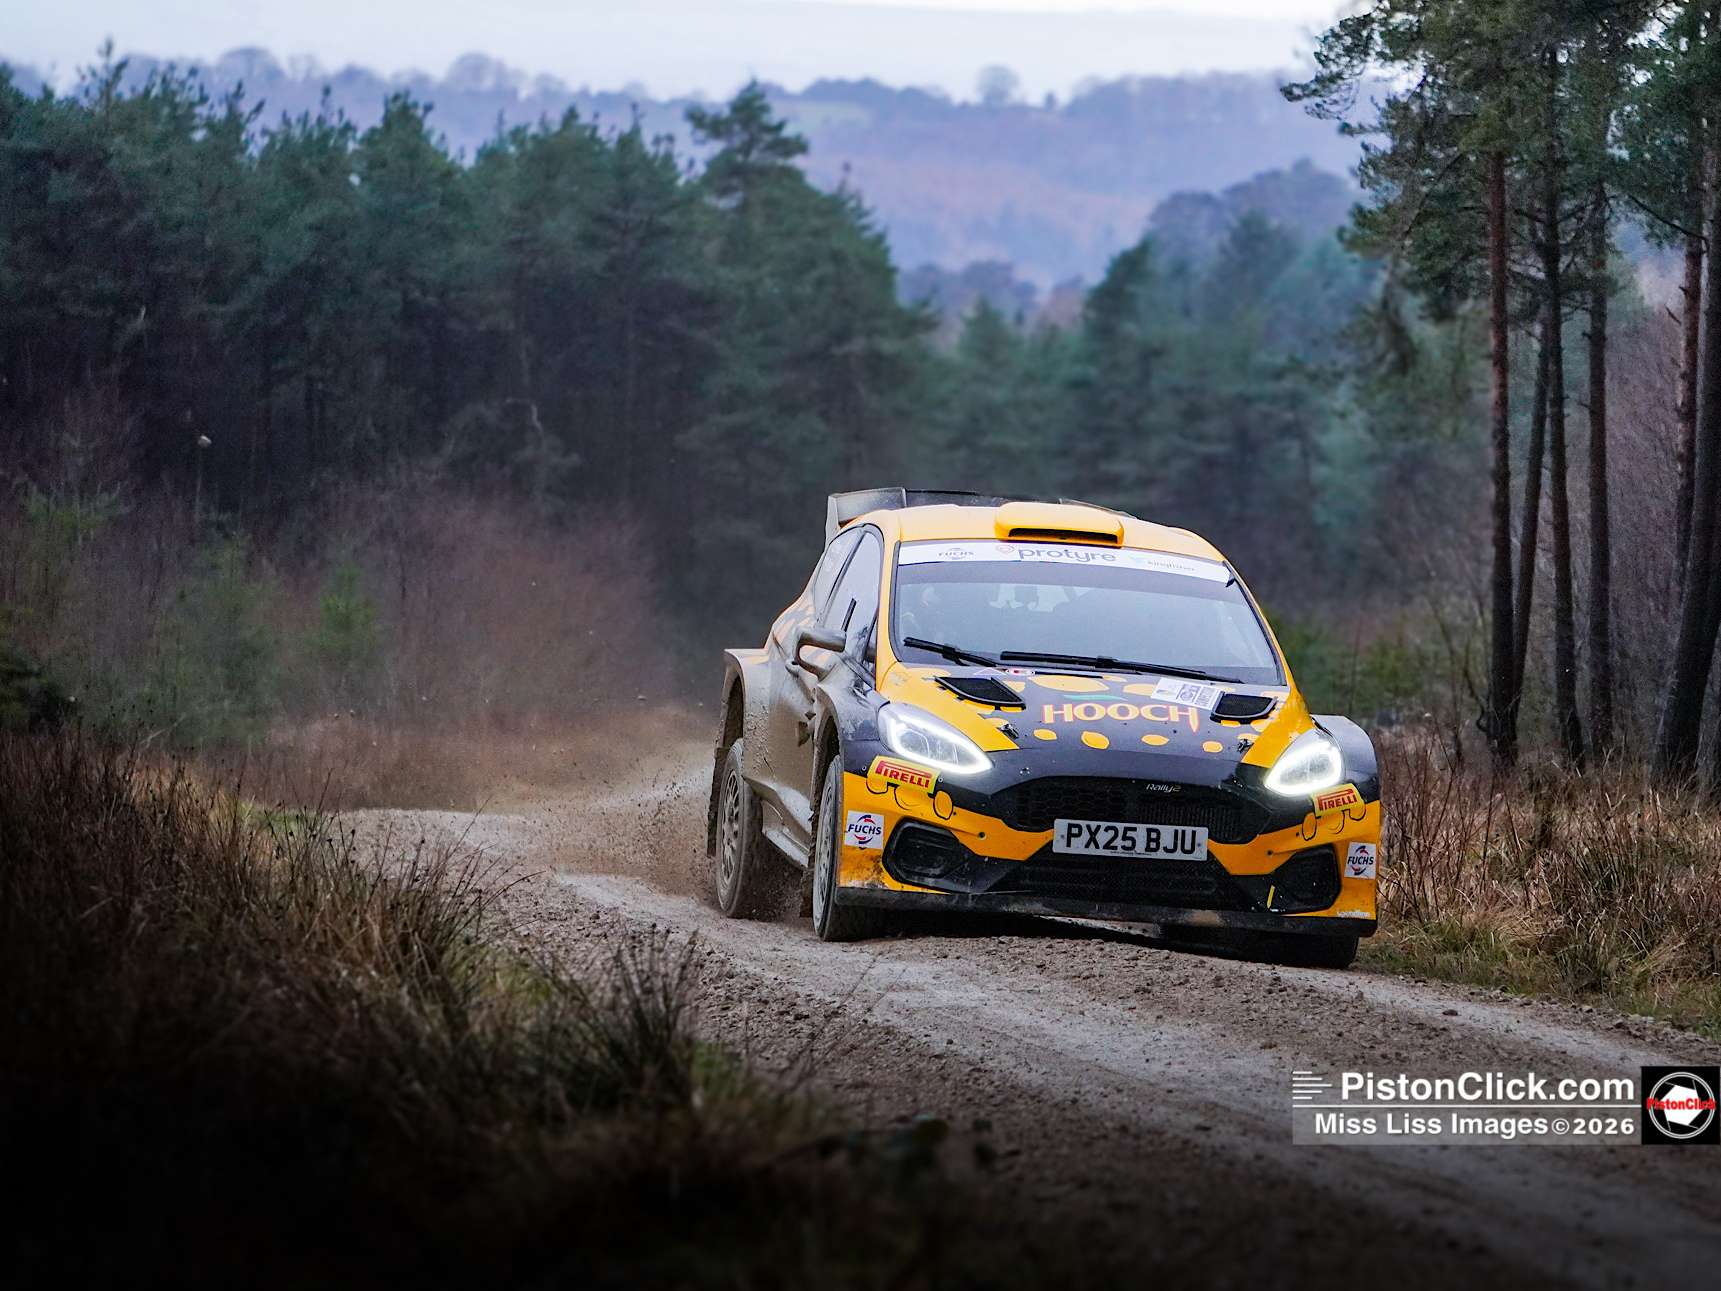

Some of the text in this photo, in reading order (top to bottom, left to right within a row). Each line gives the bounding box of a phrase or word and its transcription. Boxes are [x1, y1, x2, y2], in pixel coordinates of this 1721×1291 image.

[1018, 548, 1116, 562] protyre
[1042, 702, 1199, 733] HOOCH
[875, 760, 933, 788] PIRELLI
[1145, 783, 1181, 793] Rally2
[1316, 788, 1358, 811] PIRELLI
[847, 823, 882, 836] FUCHS
[1066, 823, 1197, 854] PX25 BJU
[1346, 856, 1374, 866] FUCHS
